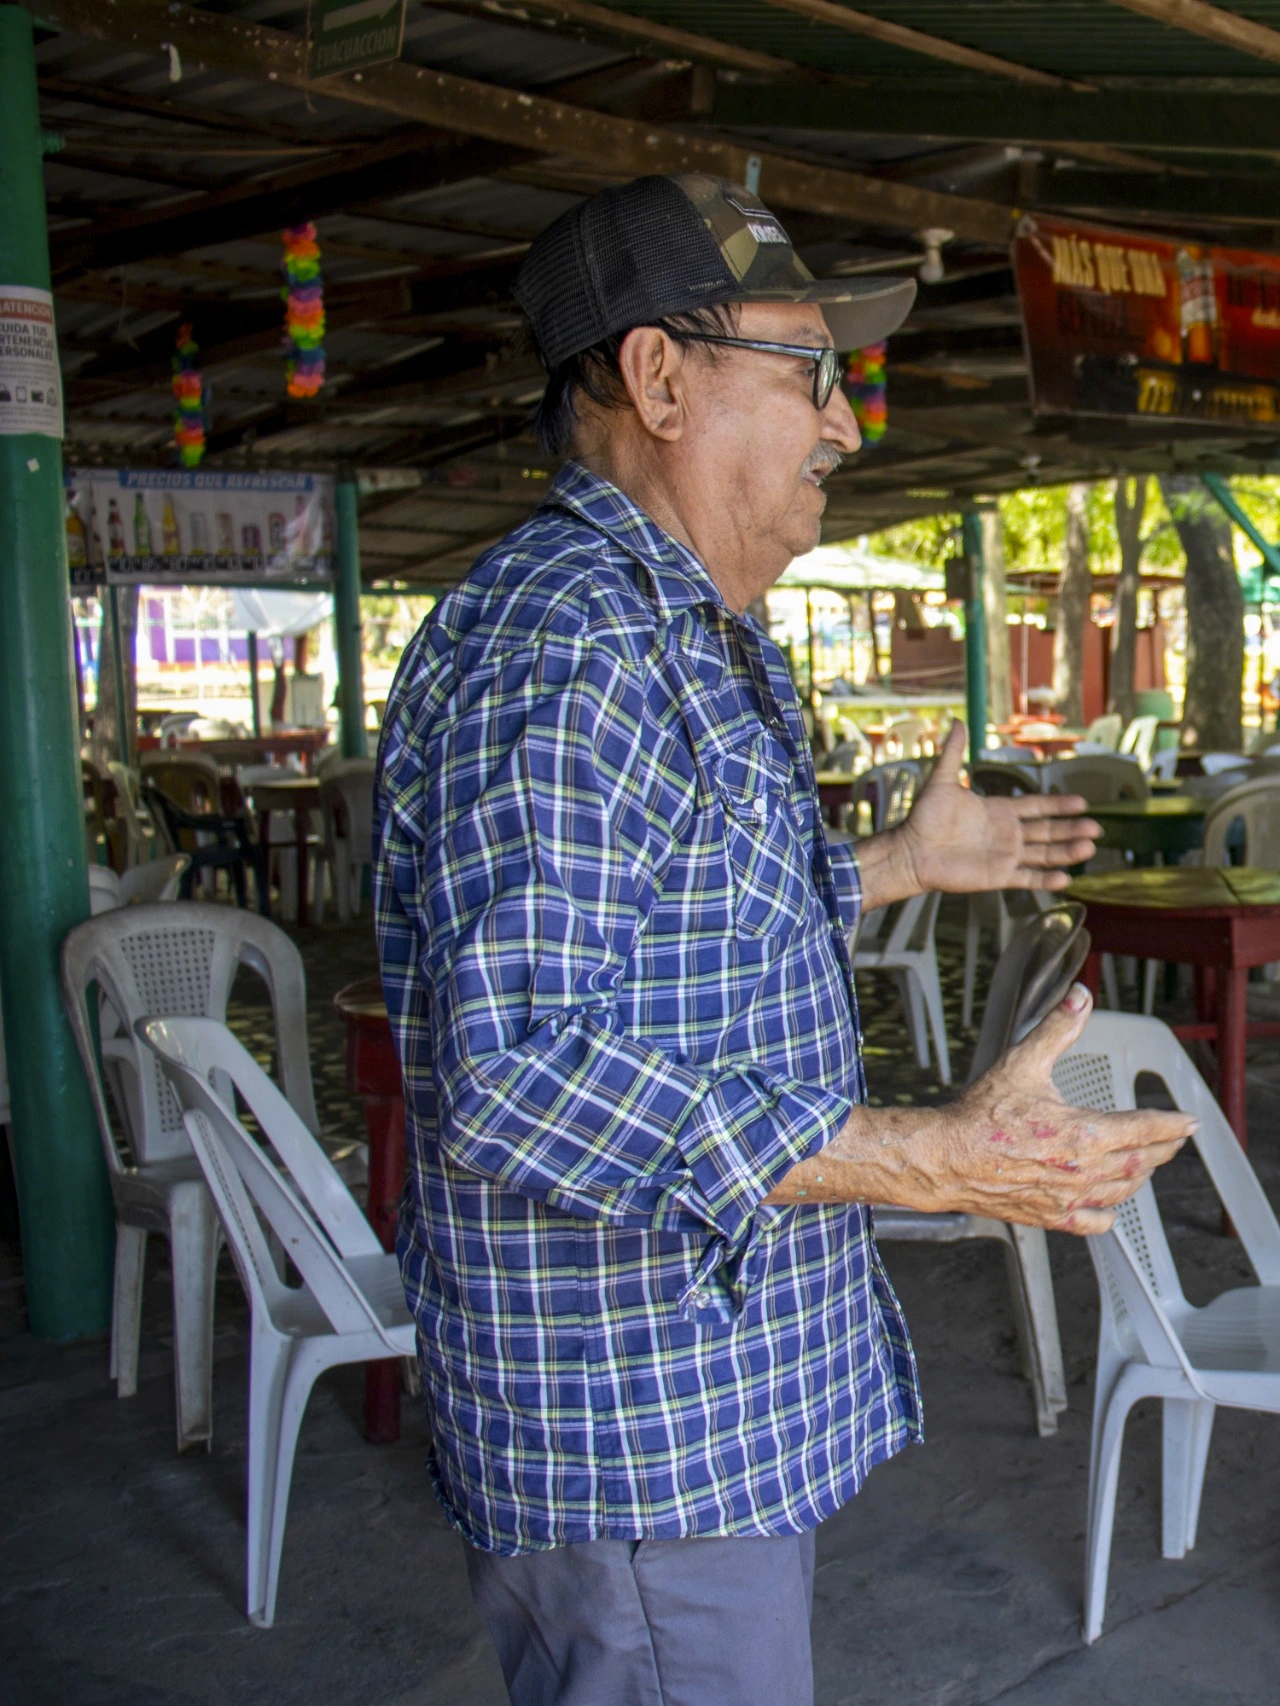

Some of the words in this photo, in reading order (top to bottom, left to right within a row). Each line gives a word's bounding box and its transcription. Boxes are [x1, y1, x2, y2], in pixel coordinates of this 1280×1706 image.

[0, 323, 29, 335] UIDA
[127, 471, 190, 487] PRECIOS
[194, 473, 223, 488] QUE
